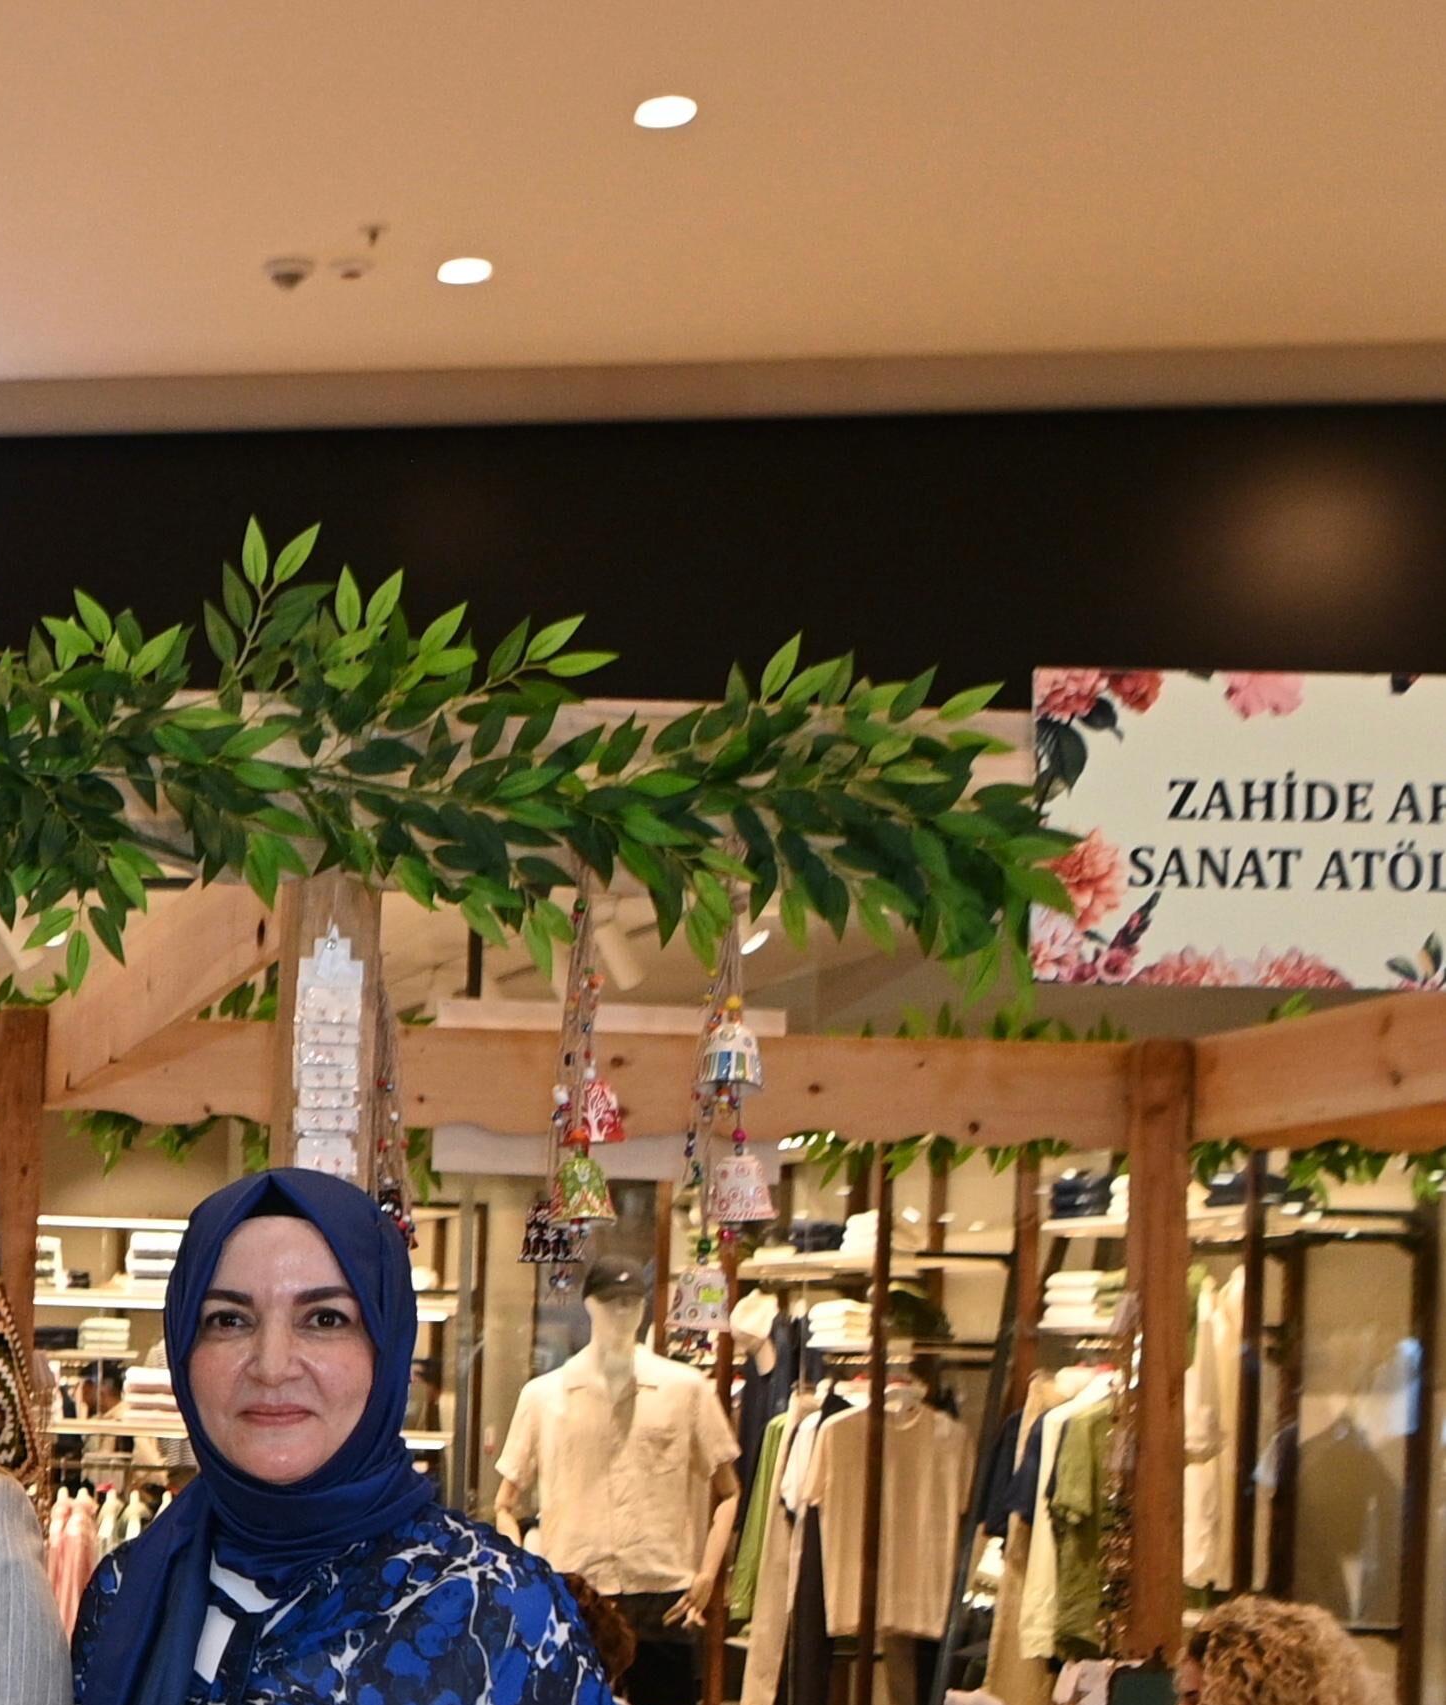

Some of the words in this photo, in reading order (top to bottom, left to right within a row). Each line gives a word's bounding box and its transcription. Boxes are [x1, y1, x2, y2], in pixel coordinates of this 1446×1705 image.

[1167, 769, 1374, 823] ZAHİDE
[1127, 846, 1302, 889] SANAT
[1315, 840, 1446, 892] ATÖL
